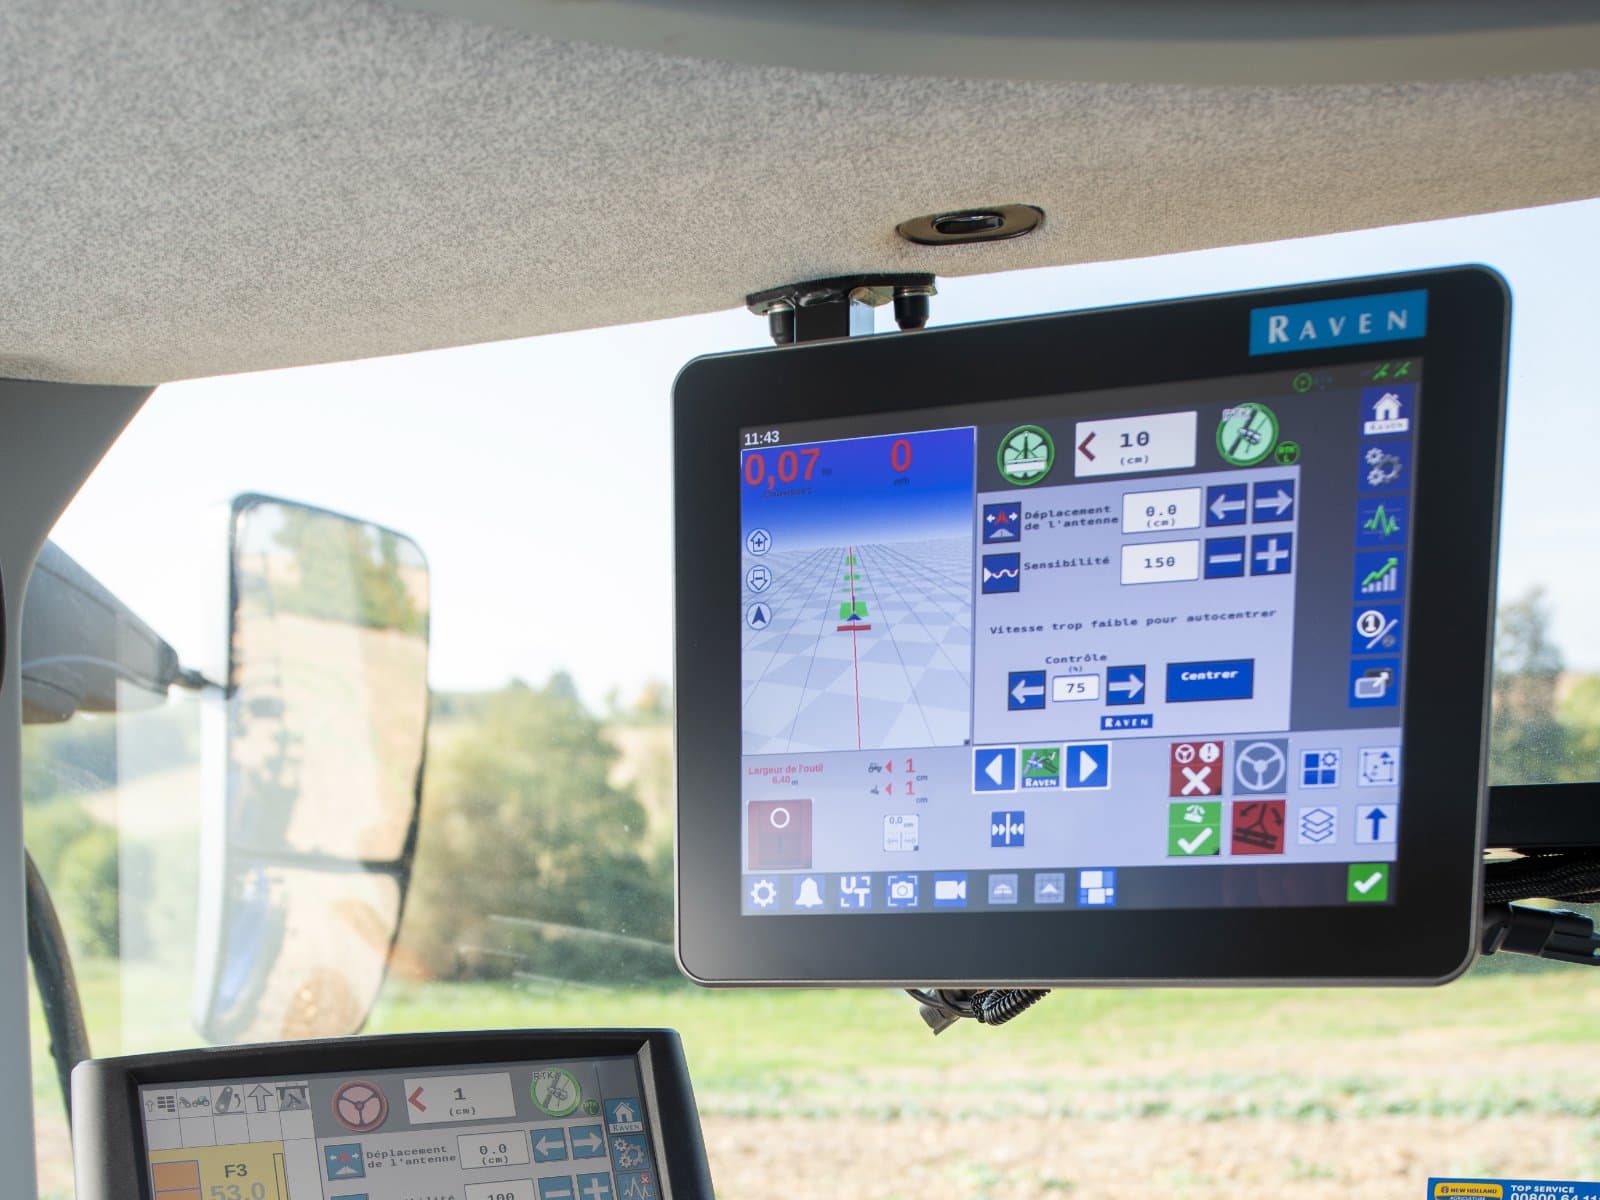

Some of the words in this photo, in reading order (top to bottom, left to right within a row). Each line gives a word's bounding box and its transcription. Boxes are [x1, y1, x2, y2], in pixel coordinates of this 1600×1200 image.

[1268, 309, 1408, 344] RAVEN
[744, 430, 780, 446] 11:43
[1120, 431, 1151, 448] 10
[891, 439, 912, 472] 0
[1120, 455, 1149, 466] (cm)
[745, 448, 821, 490] 0,07
[1024, 505, 1111, 521] Déplacement
[1146, 504, 1177, 517] 0.0
[1024, 521, 1040, 530] de
[1049, 515, 1119, 528] l'antenne
[1146, 517, 1176, 528] (cm)
[1024, 556, 1110, 571] Sensibilité
[1144, 556, 1176, 569] 150
[990, 625, 1044, 635] Vitesse
[1052, 621, 1083, 633] trop
[1091, 618, 1138, 629] faible
[1146, 615, 1177, 627] pour
[1186, 609, 1277, 623] autocentrer
[1045, 653, 1107, 665] Contrôle
[1181, 669, 1240, 681] Centrer
[1066, 683, 1086, 694] 75
[1104, 716, 1149, 729] RAVEN
[748, 766, 783, 775] Largeur
[785, 765, 796, 774] de
[799, 763, 823, 773] l'outil
[906, 758, 915, 773] 1
[906, 781, 915, 795] 1
[1025, 777, 1058, 788] RAVEN
[453, 1087, 466, 1101] 1
[449, 1106, 476, 1117] (cm)
[366, 1145, 447, 1159] Déplacement
[479, 1143, 507, 1155] 0.0
[367, 1160, 383, 1168] de
[392, 1154, 456, 1166] l'antenne
[481, 1154, 508, 1165] (cm)
[224, 1164, 248, 1178] F3
[1511, 1184, 1531, 1192] TOP
[1534, 1185, 1574, 1193] SERVICE
